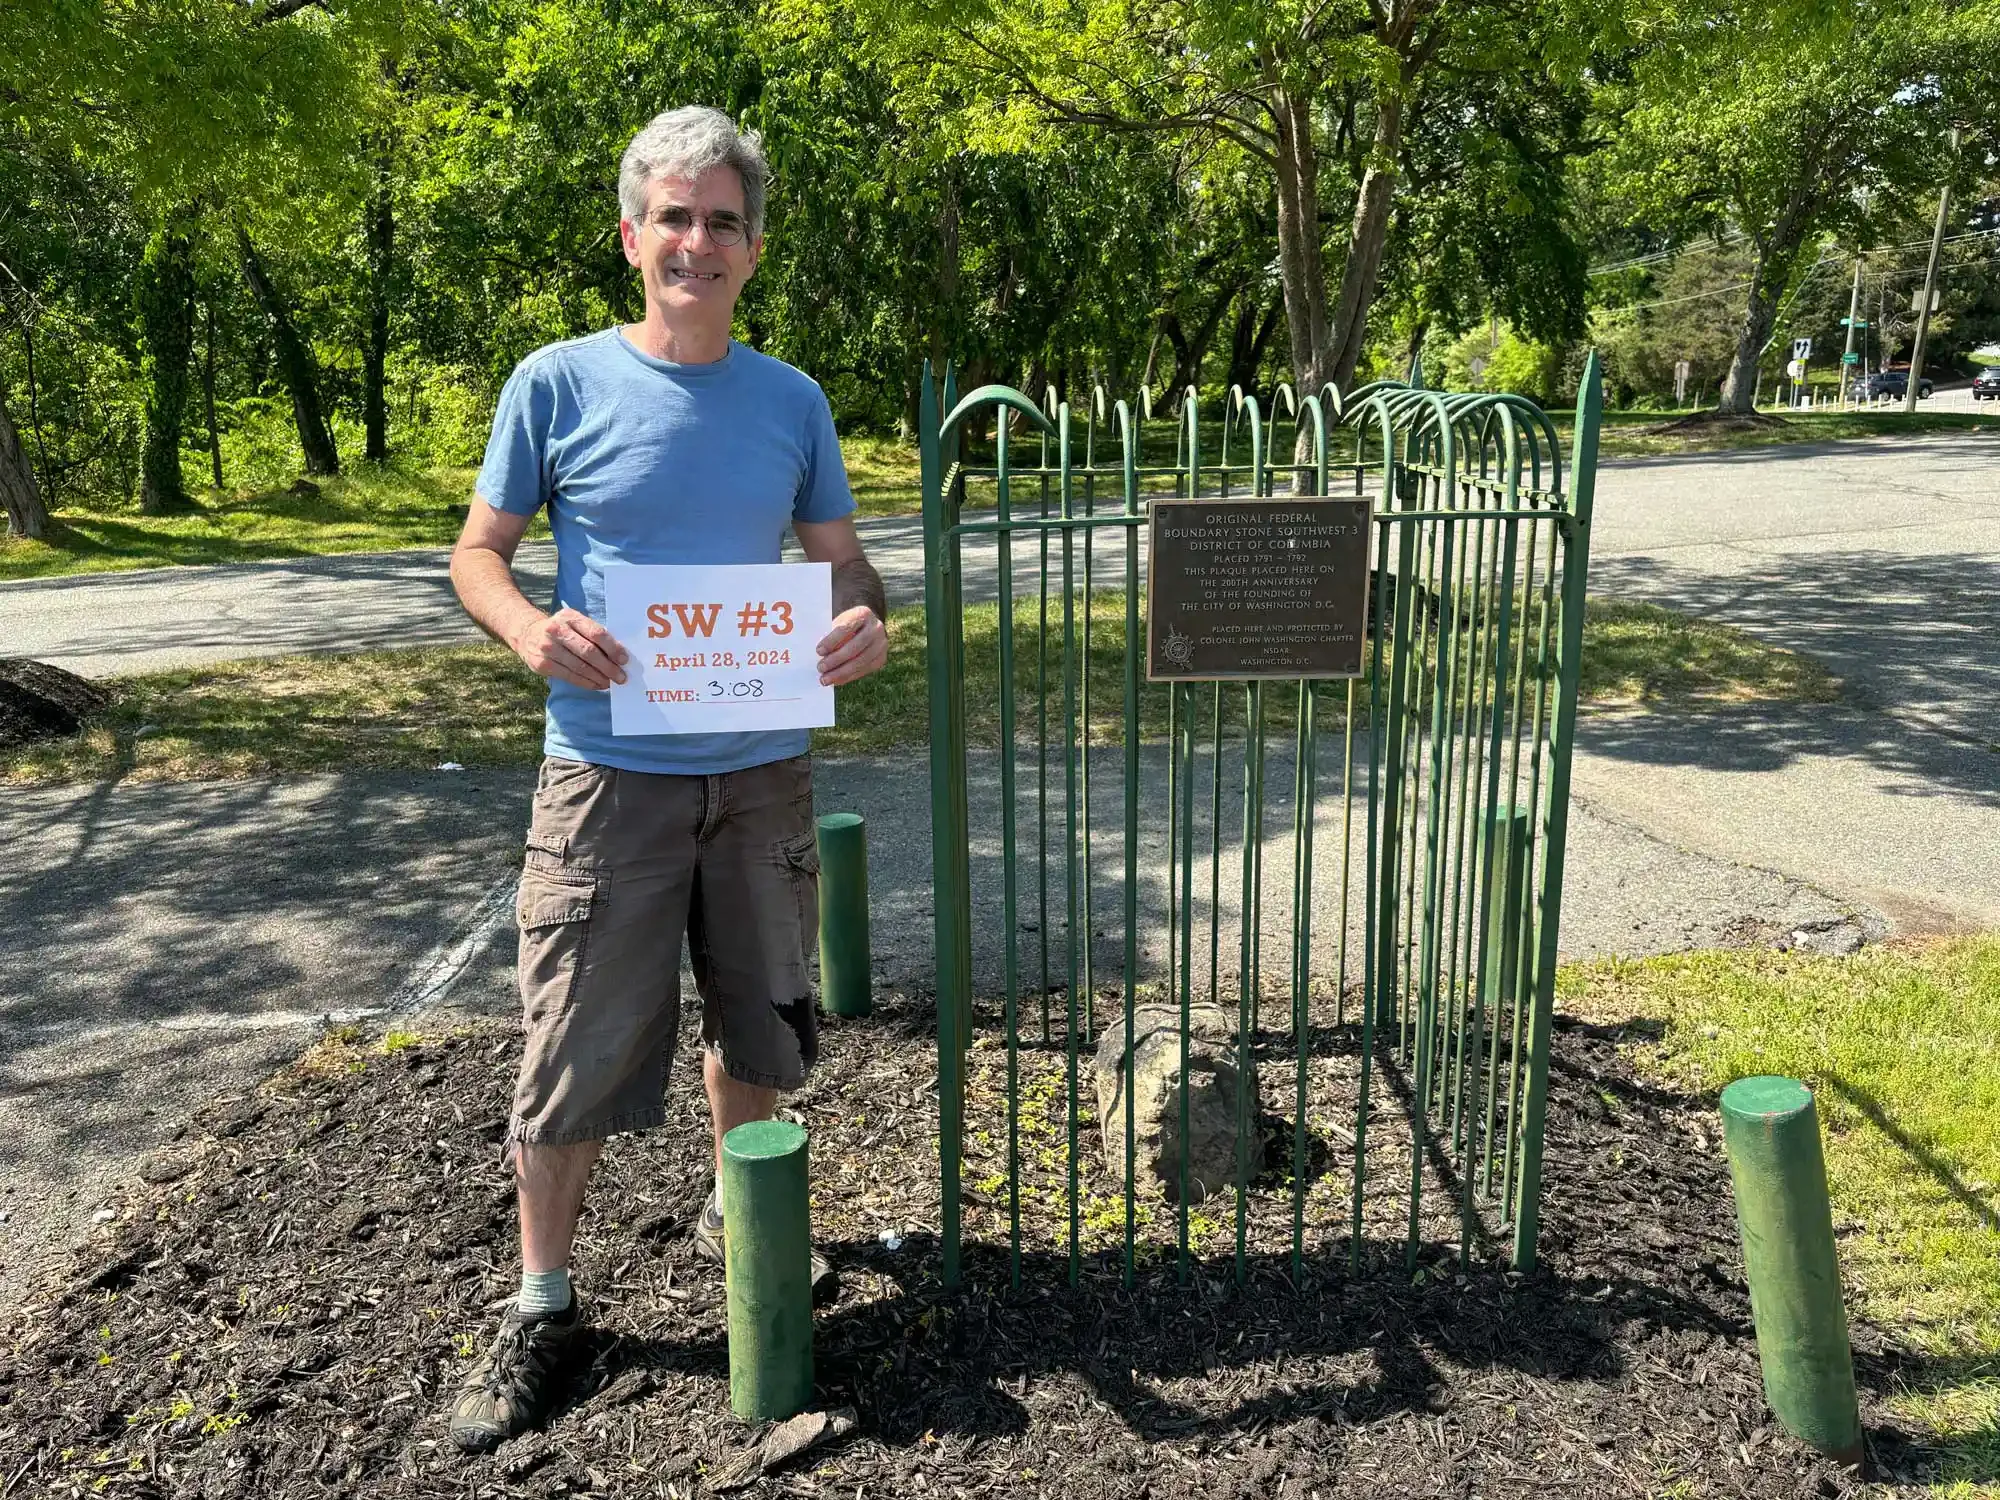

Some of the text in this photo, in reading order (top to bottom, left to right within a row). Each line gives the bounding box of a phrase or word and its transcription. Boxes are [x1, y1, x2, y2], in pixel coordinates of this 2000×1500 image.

[1206, 513, 1317, 524] ORIGINAL FEDERAL
[1164, 525, 1358, 538] BOUNDARY STONE SOUTHWEST 3
[1190, 541, 1241, 550] DISTRICT
[1248, 540, 1263, 549] OF
[1214, 555, 1249, 563] PLACED
[1254, 554, 1273, 562] 1791
[1287, 554, 1306, 562] 1792
[1184, 565, 1335, 576] THIS PLAQUE PLACED HERE ON
[1200, 577, 1319, 587] THE 200TH ANNIVERSARY
[1204, 591, 1216, 599] OF
[1244, 589, 1295, 598] FOUNDING
[1300, 589, 1312, 597] OF
[1181, 601, 1335, 611] THE CITY OF WASHINGTON D.C.
[646, 600, 794, 639] SW #3
[1212, 625, 1241, 633] PLACED
[1266, 624, 1284, 632] AND
[1287, 624, 1331, 632] PROTECTED
[1334, 623, 1344, 631] BY
[1240, 636, 1260, 644] JOHN
[1263, 635, 1316, 643] WASHINGTON
[654, 649, 791, 672] April 28, 2024
[1296, 657, 1312, 665] D.C.
[645, 678, 764, 703] TIME: 3:08
